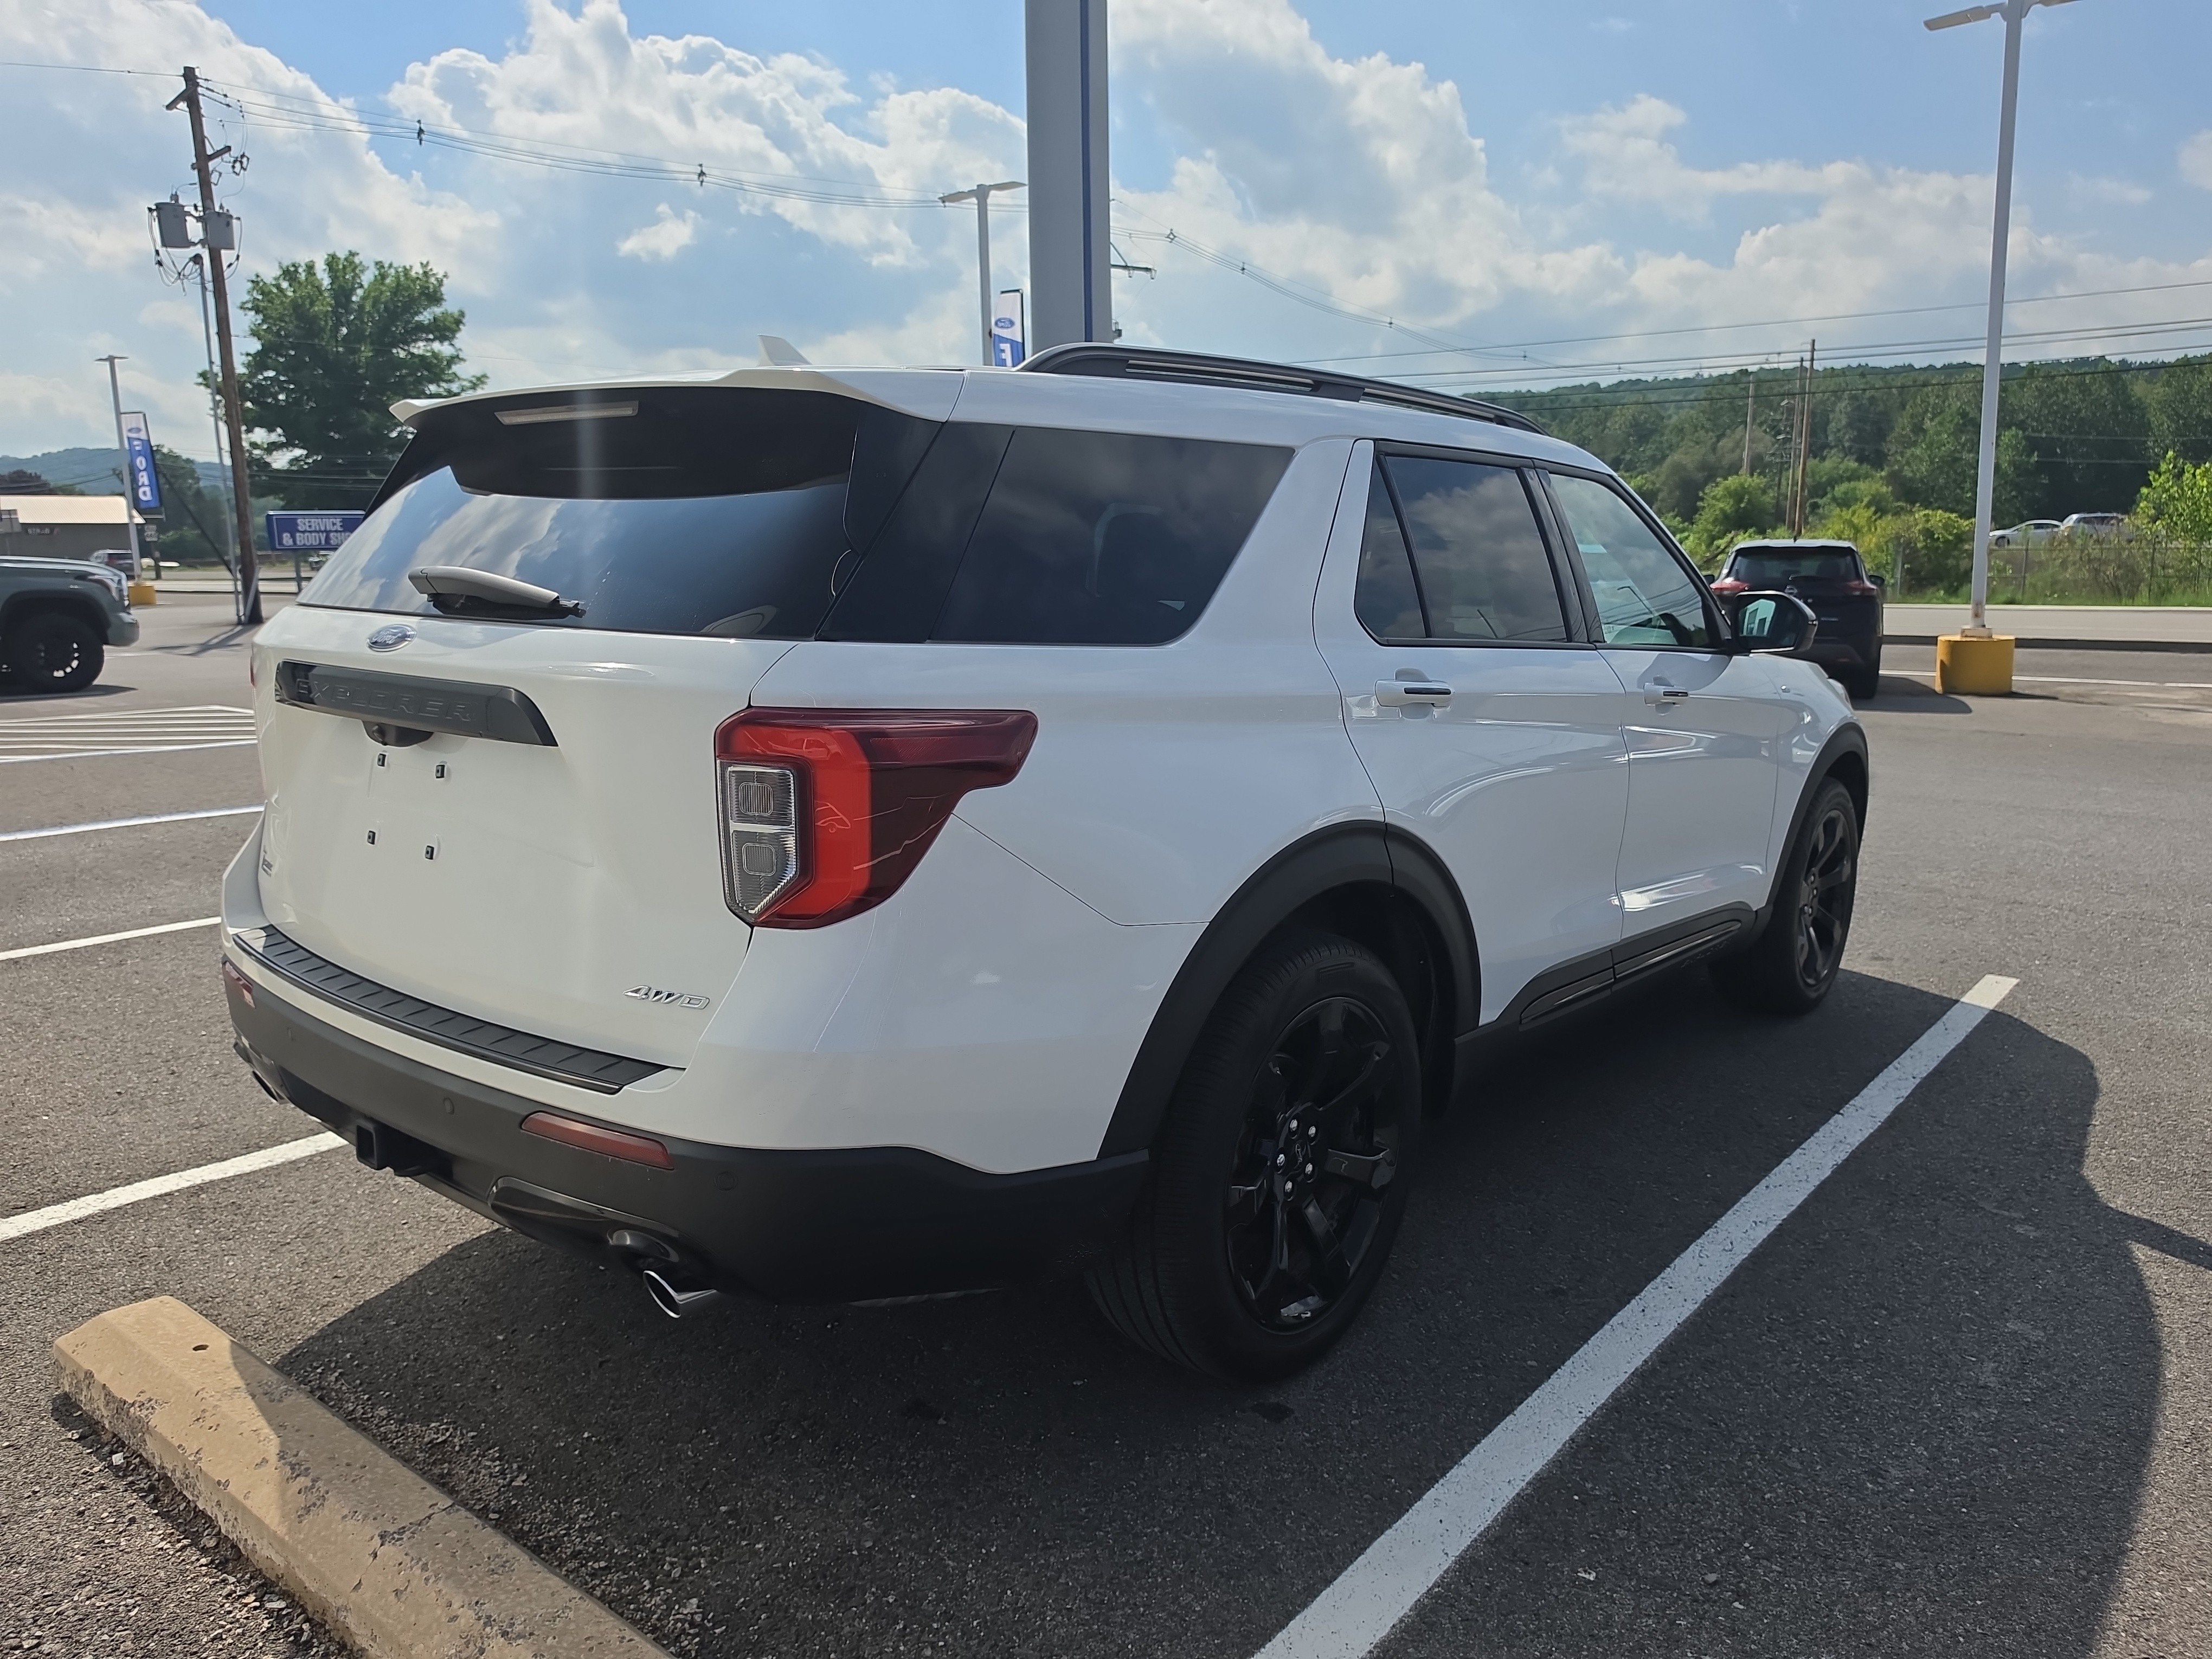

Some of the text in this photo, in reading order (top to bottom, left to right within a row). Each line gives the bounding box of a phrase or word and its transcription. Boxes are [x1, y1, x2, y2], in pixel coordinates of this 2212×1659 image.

[297, 518, 344, 531] SERVICE
[282, 531, 353, 546] & BODY SHO
[296, 678, 472, 722] EXPLORER
[622, 985, 710, 1010] 4WD
